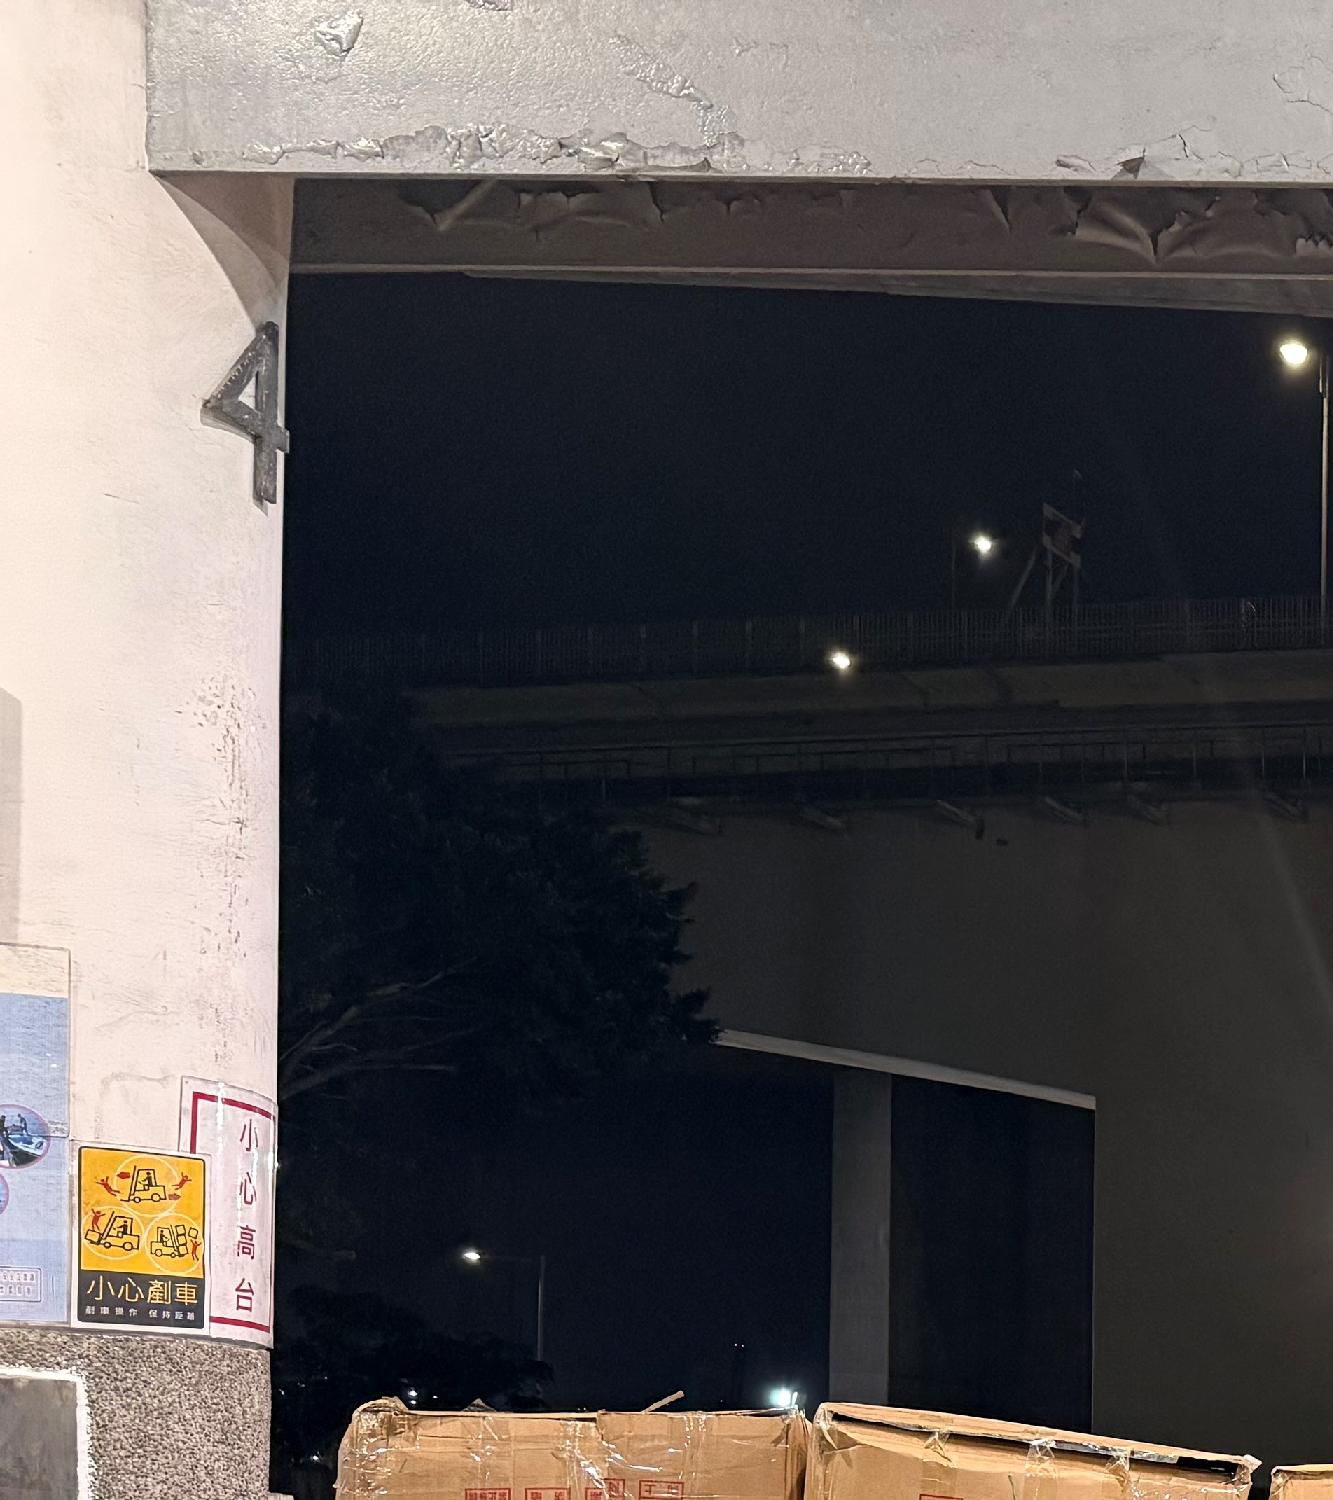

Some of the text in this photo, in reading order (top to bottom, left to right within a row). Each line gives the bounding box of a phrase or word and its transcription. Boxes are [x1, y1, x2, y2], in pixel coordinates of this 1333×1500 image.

[234, 1119, 259, 1313] 小心高台
[87, 1275, 198, 1306] 小心剷車
